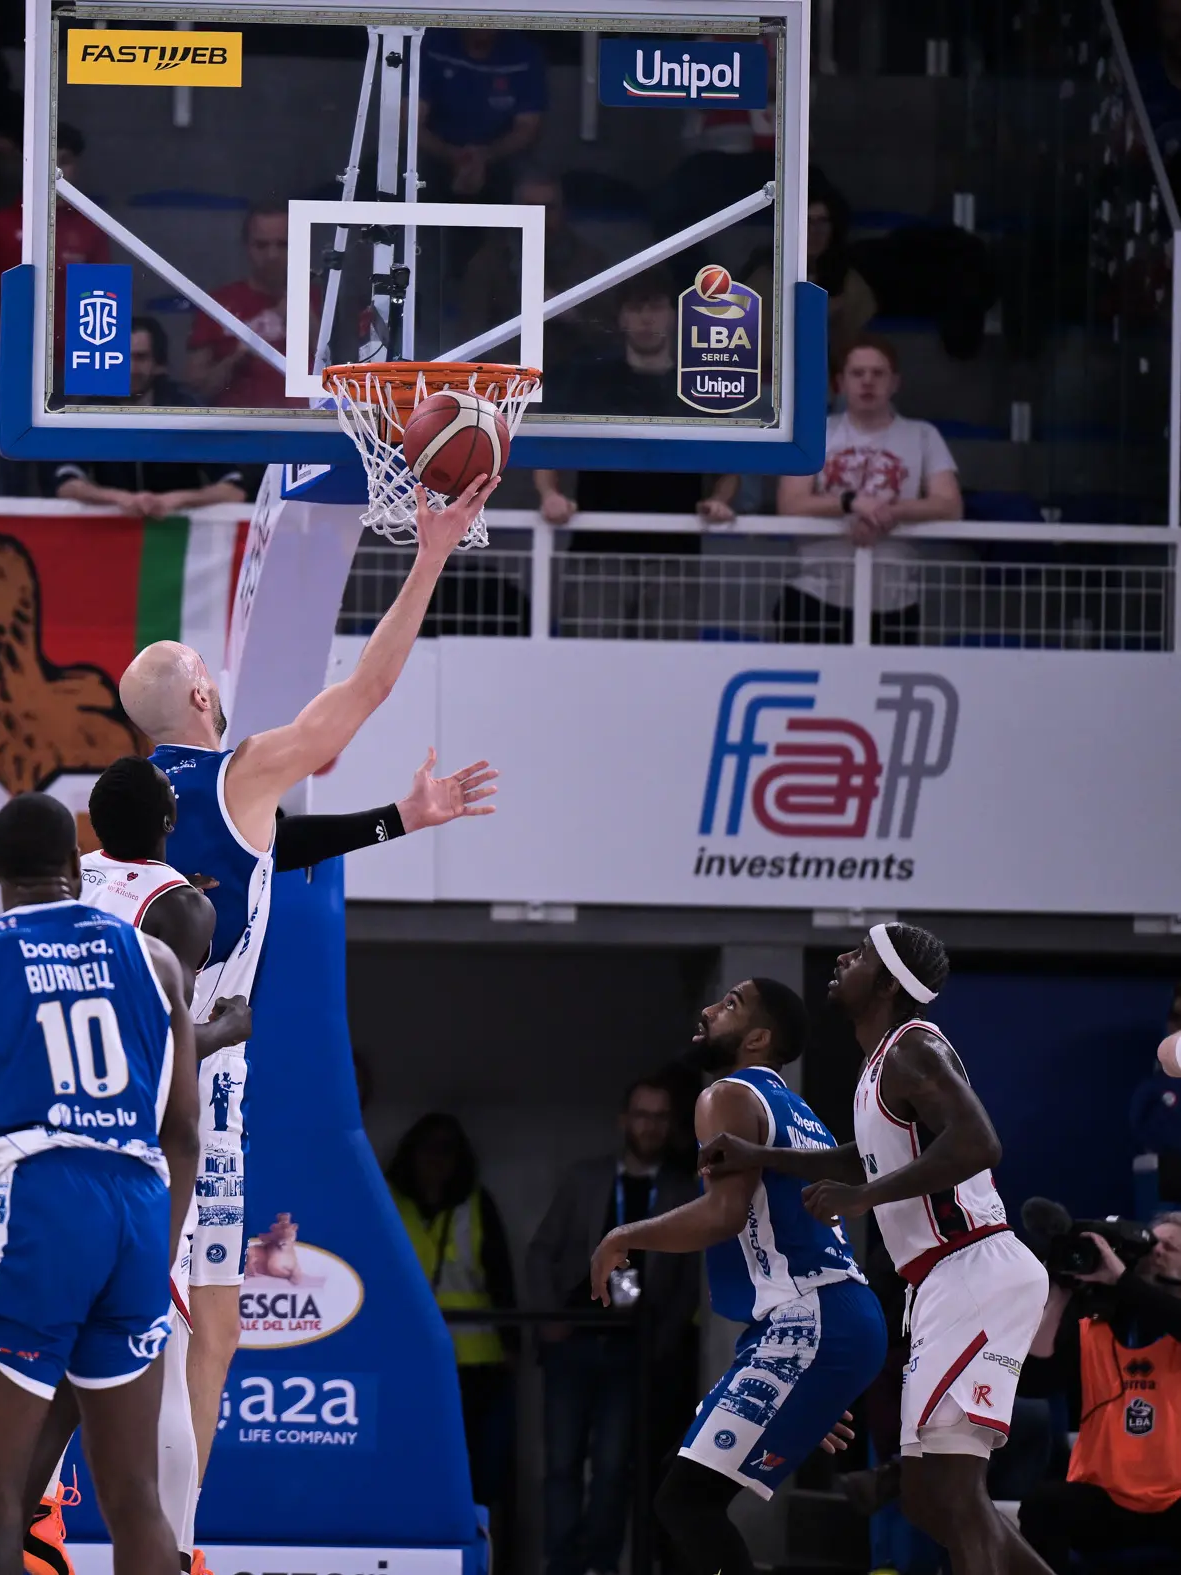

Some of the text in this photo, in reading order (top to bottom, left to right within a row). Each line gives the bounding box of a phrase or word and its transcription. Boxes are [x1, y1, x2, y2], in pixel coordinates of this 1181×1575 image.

[81, 45, 228, 71] FASTWEB
[636, 49, 741, 98] Unipol
[691, 325, 752, 349] LBA
[72, 351, 124, 370] FIP
[701, 353, 740, 362] SERIE A
[696, 375, 745, 398] Unipol
[693, 847, 916, 881] investments
[19, 939, 114, 960] bonera.
[24, 961, 115, 994] BURNELL
[36, 997, 129, 1098] 10
[74, 1105, 138, 1128] inblu
[262, 1320, 283, 1331] DEL
[288, 1320, 322, 1331] LATTE
[239, 1376, 359, 1426] a2a
[1129, 1418, 1150, 1427] LBA
[239, 1428, 358, 1445] LIFE COMPANY
